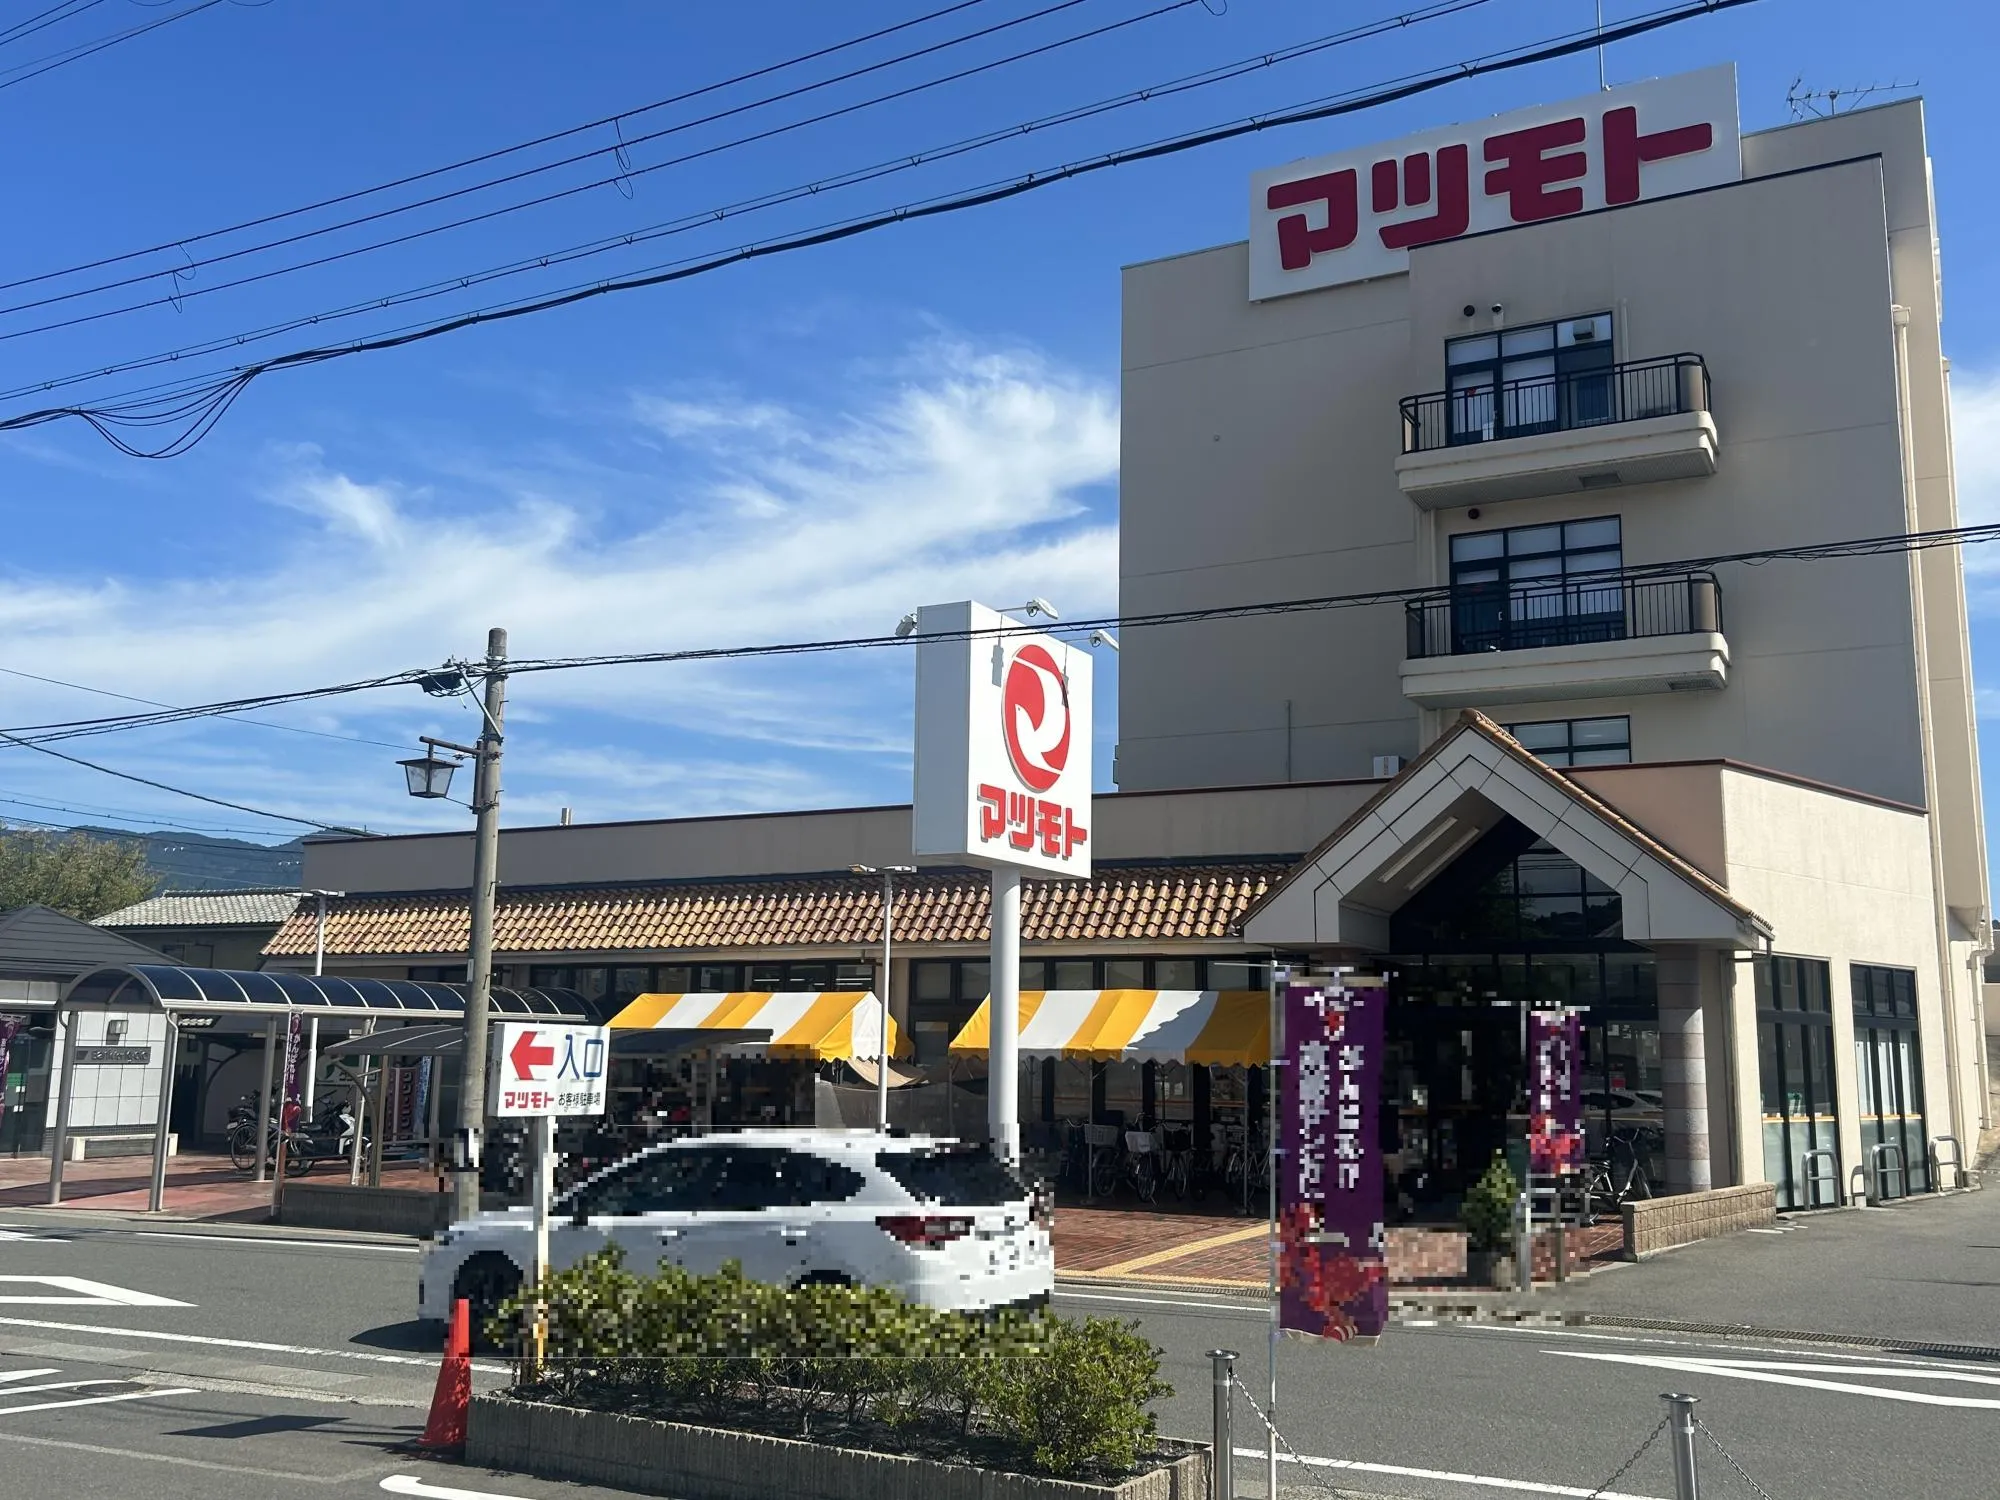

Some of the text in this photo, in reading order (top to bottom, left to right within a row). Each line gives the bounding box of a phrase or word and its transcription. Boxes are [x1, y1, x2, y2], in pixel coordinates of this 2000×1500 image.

[1267, 105, 1713, 271] マツモト
[976, 783, 1088, 860] マツモト
[557, 1033, 604, 1080] 入口
[504, 1091, 555, 1109] マツモト
